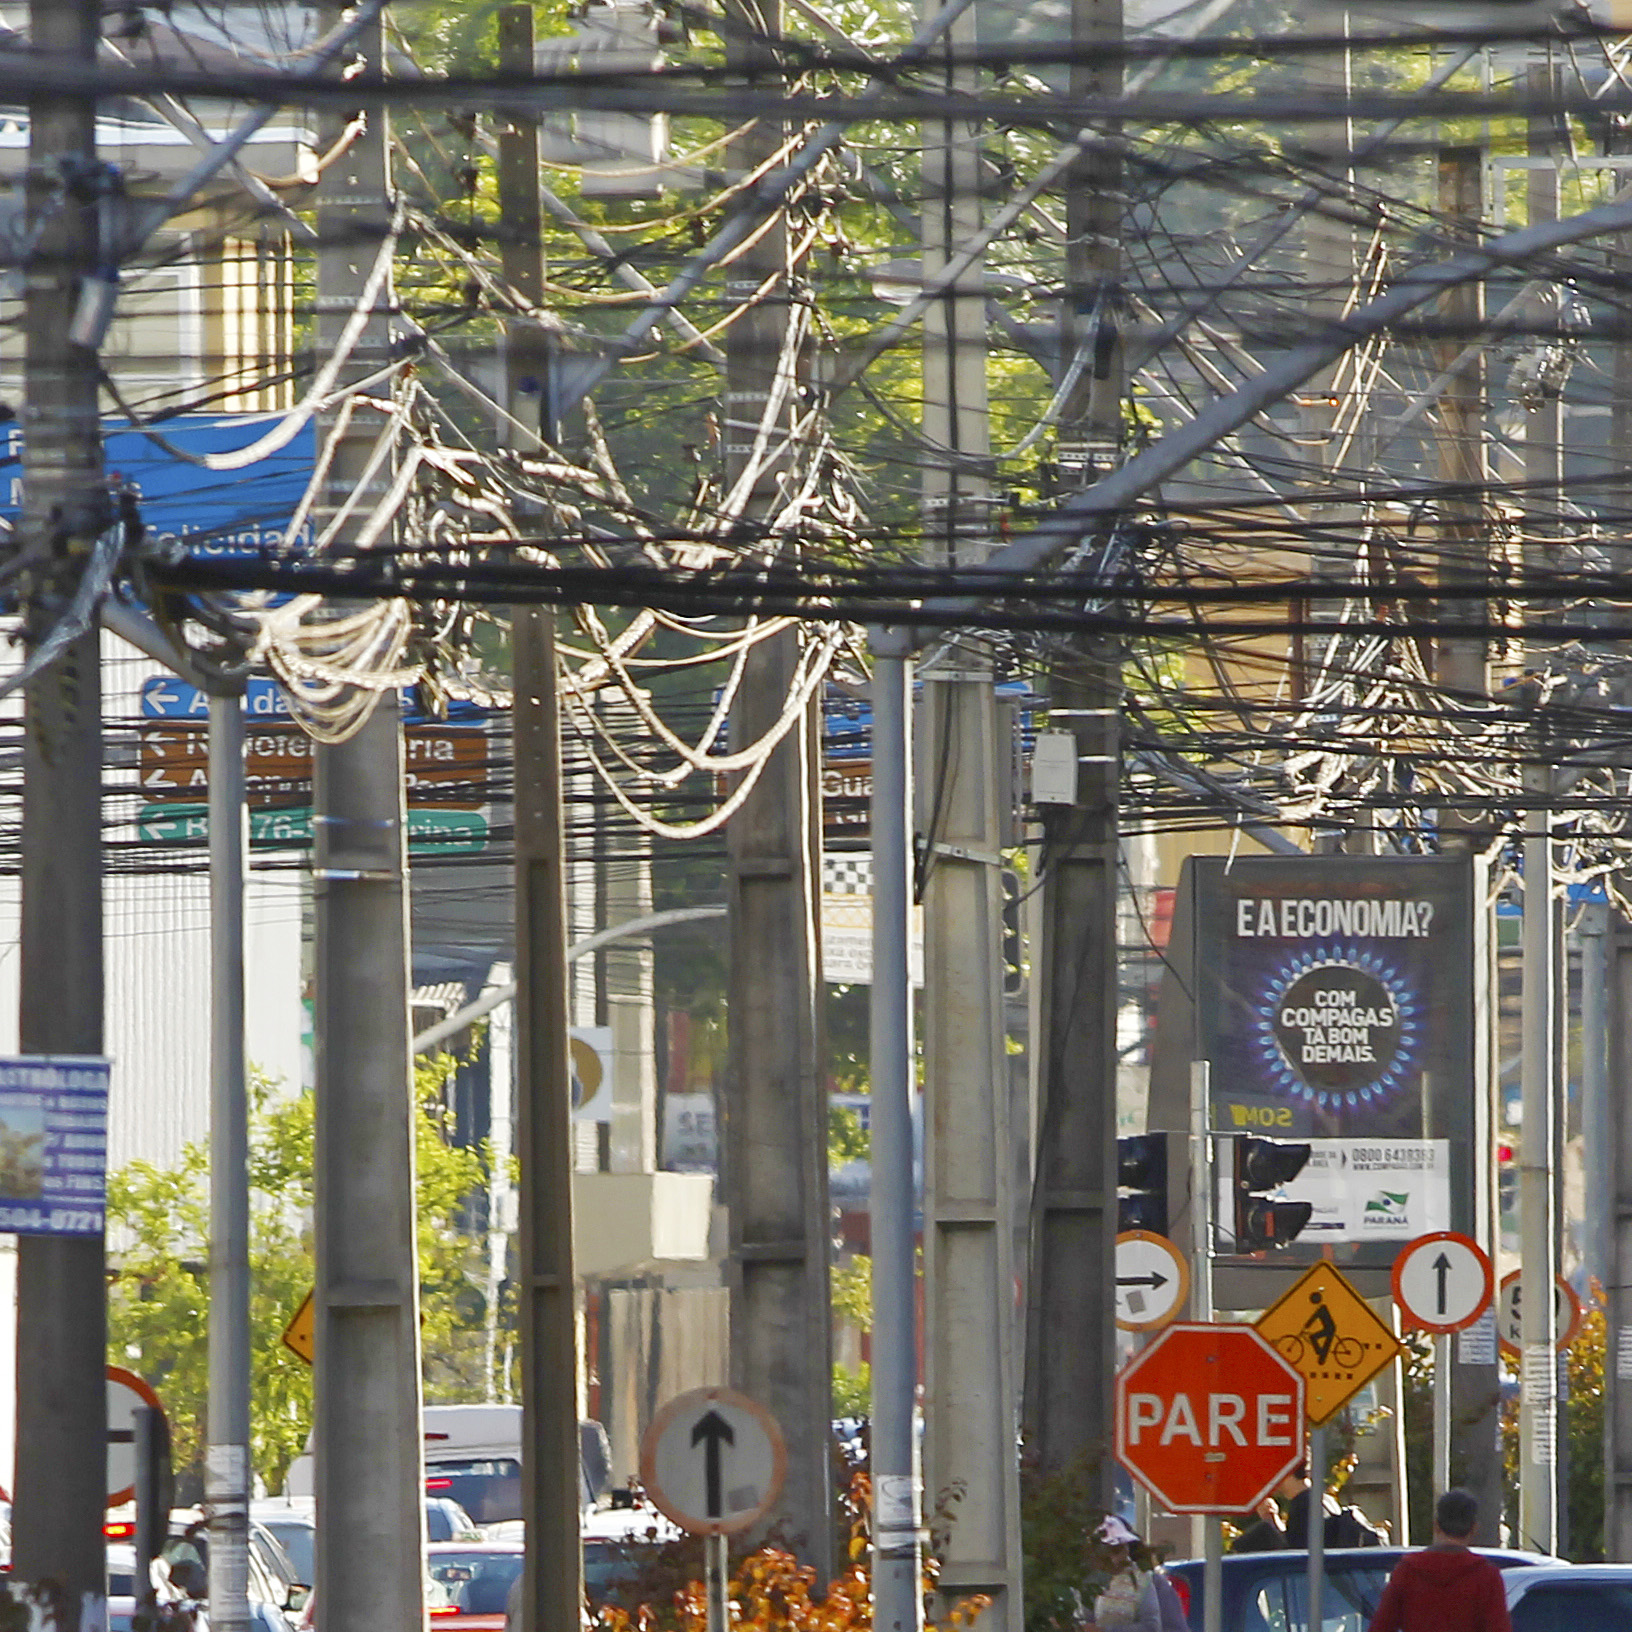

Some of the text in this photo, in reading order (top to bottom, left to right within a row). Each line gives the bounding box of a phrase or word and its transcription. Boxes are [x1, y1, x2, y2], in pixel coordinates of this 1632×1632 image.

[1237, 899, 1435, 938] E A ECONOMIA?
[1314, 990, 1357, 1007] COM
[1281, 1008, 1394, 1028] COMPAGAS
[1327, 1027, 1369, 1045] BOM
[1128, 1392, 1291, 1447] PARE
